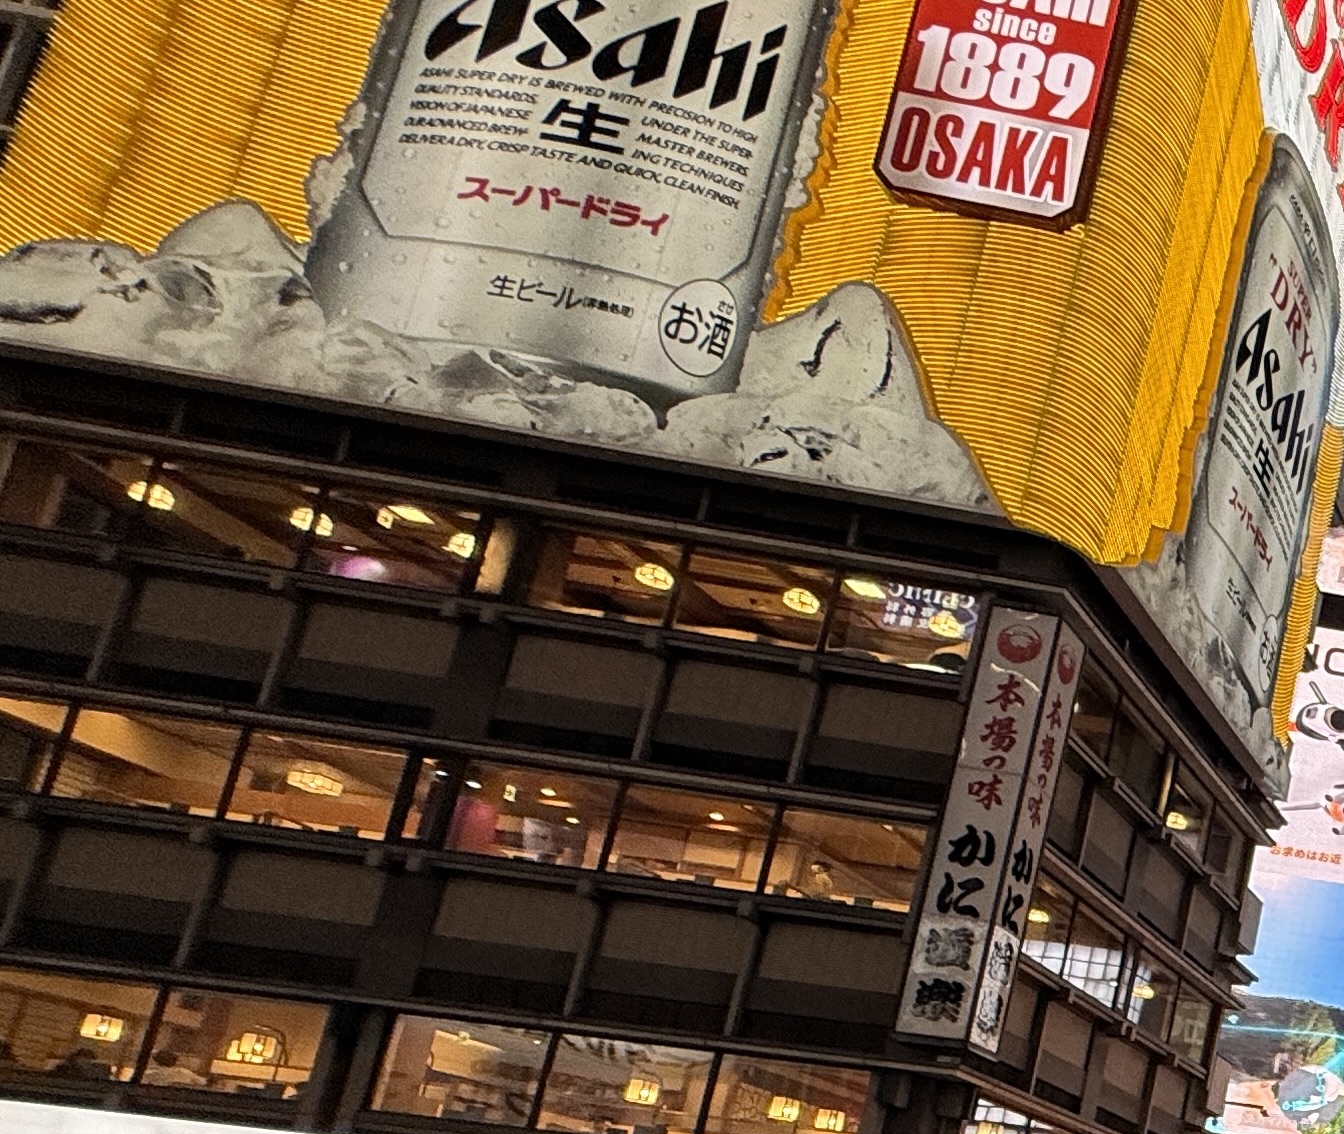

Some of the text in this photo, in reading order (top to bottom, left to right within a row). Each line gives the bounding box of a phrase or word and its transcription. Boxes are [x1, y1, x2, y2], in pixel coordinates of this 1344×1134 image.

[973, 8, 1057, 45] since
[913, 24, 1096, 119] 1889
[455, 68, 497, 81] SUPER
[498, 73, 528, 85] DRY
[528, 76, 543, 87] IS
[544, 79, 606, 98] BREWED
[609, 90, 646, 108] WITH
[648, 100, 717, 127] PRECISION
[718, 121, 733, 134] TO
[732, 128, 759, 144] HIGH
[540, 98, 630, 155] 生
[641, 116, 691, 138] UNDER
[693, 128, 718, 147] THE
[530, 145, 577, 164] TASTE
[577, 155, 612, 170] AND
[664, 176, 706, 196] CLEAN
[631, 148, 744, 193] ING TECHNIQUES
[636, 133, 696, 157] MASTER
[890, 106, 1069, 203] OSAKA
[458, 176, 671, 237] スーパードライ
[664, 302, 735, 360] お酒
[1236, 308, 1314, 495] Asahi
